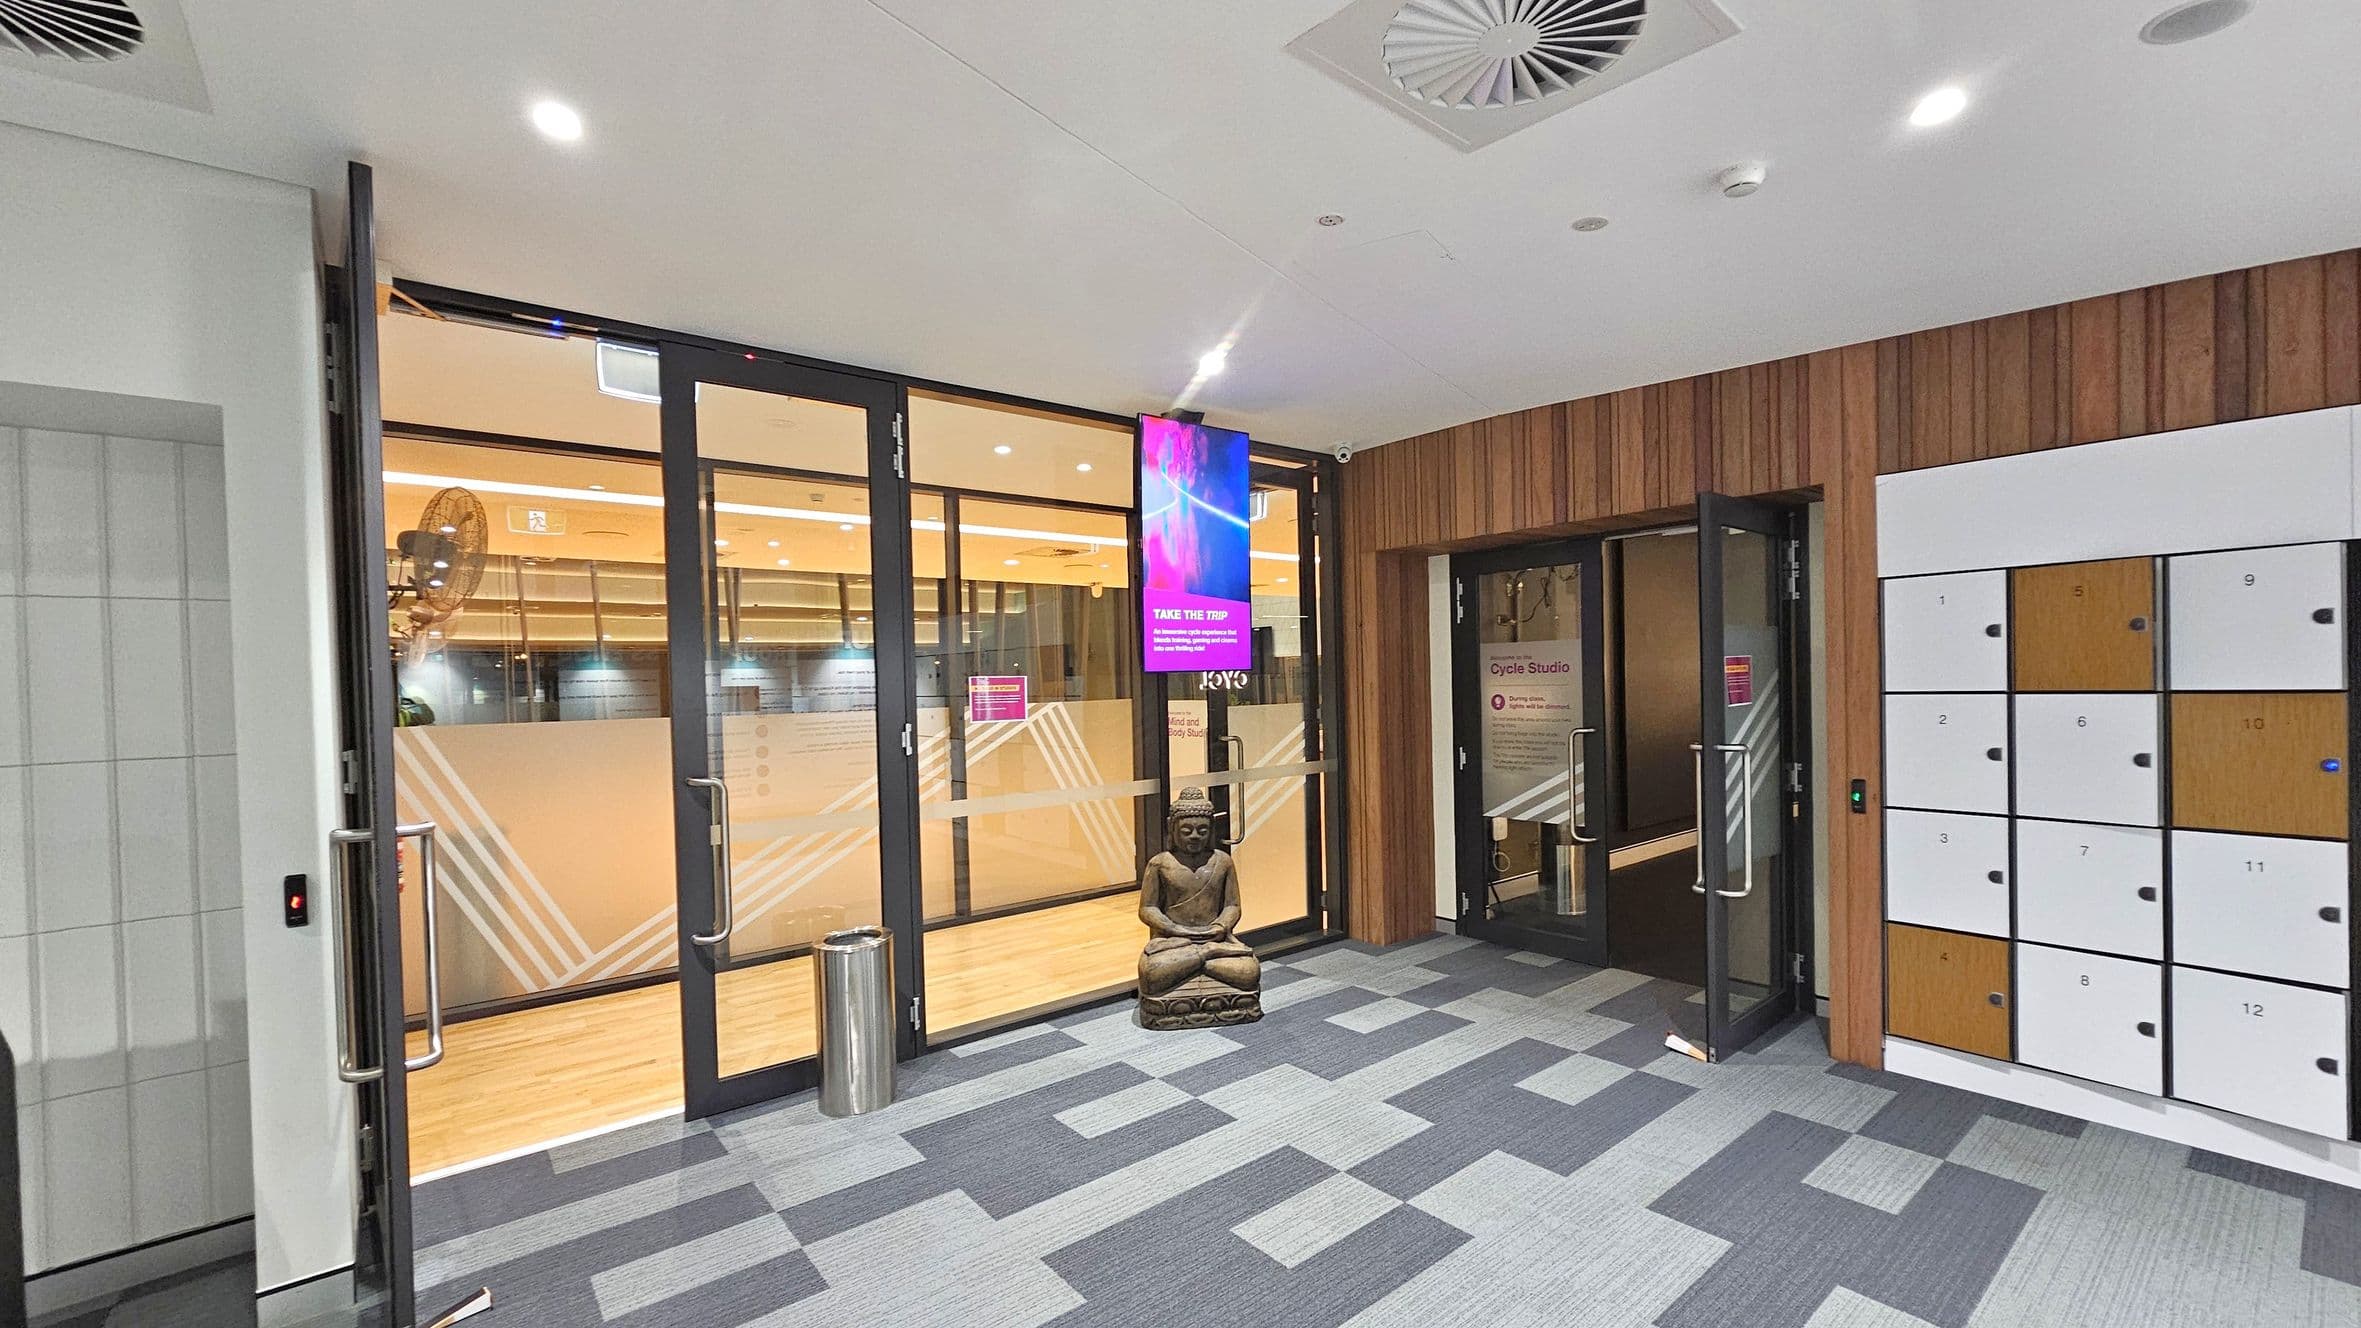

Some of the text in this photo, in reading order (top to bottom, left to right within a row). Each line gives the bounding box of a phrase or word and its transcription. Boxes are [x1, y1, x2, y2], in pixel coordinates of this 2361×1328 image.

[2244, 573, 2255, 587] 9
[2074, 586, 2084, 597] 5
[1939, 595, 1945, 606] 1
[1153, 609, 1228, 621] TAKE THE TRIP
[1491, 661, 1570, 676] Cycle Studio
[1187, 717, 1200, 726] and
[1939, 714, 1947, 725] 2
[2077, 716, 2086, 727] 6
[2244, 717, 2264, 730] 10
[1167, 728, 1185, 739] Body
[1939, 832, 1948, 844] 3
[2080, 845, 2090, 857] 7
[2244, 860, 2264, 873] 11
[1940, 951, 1948, 962] 4
[2080, 975, 2089, 987] 8
[2243, 1003, 2264, 1017] 12
